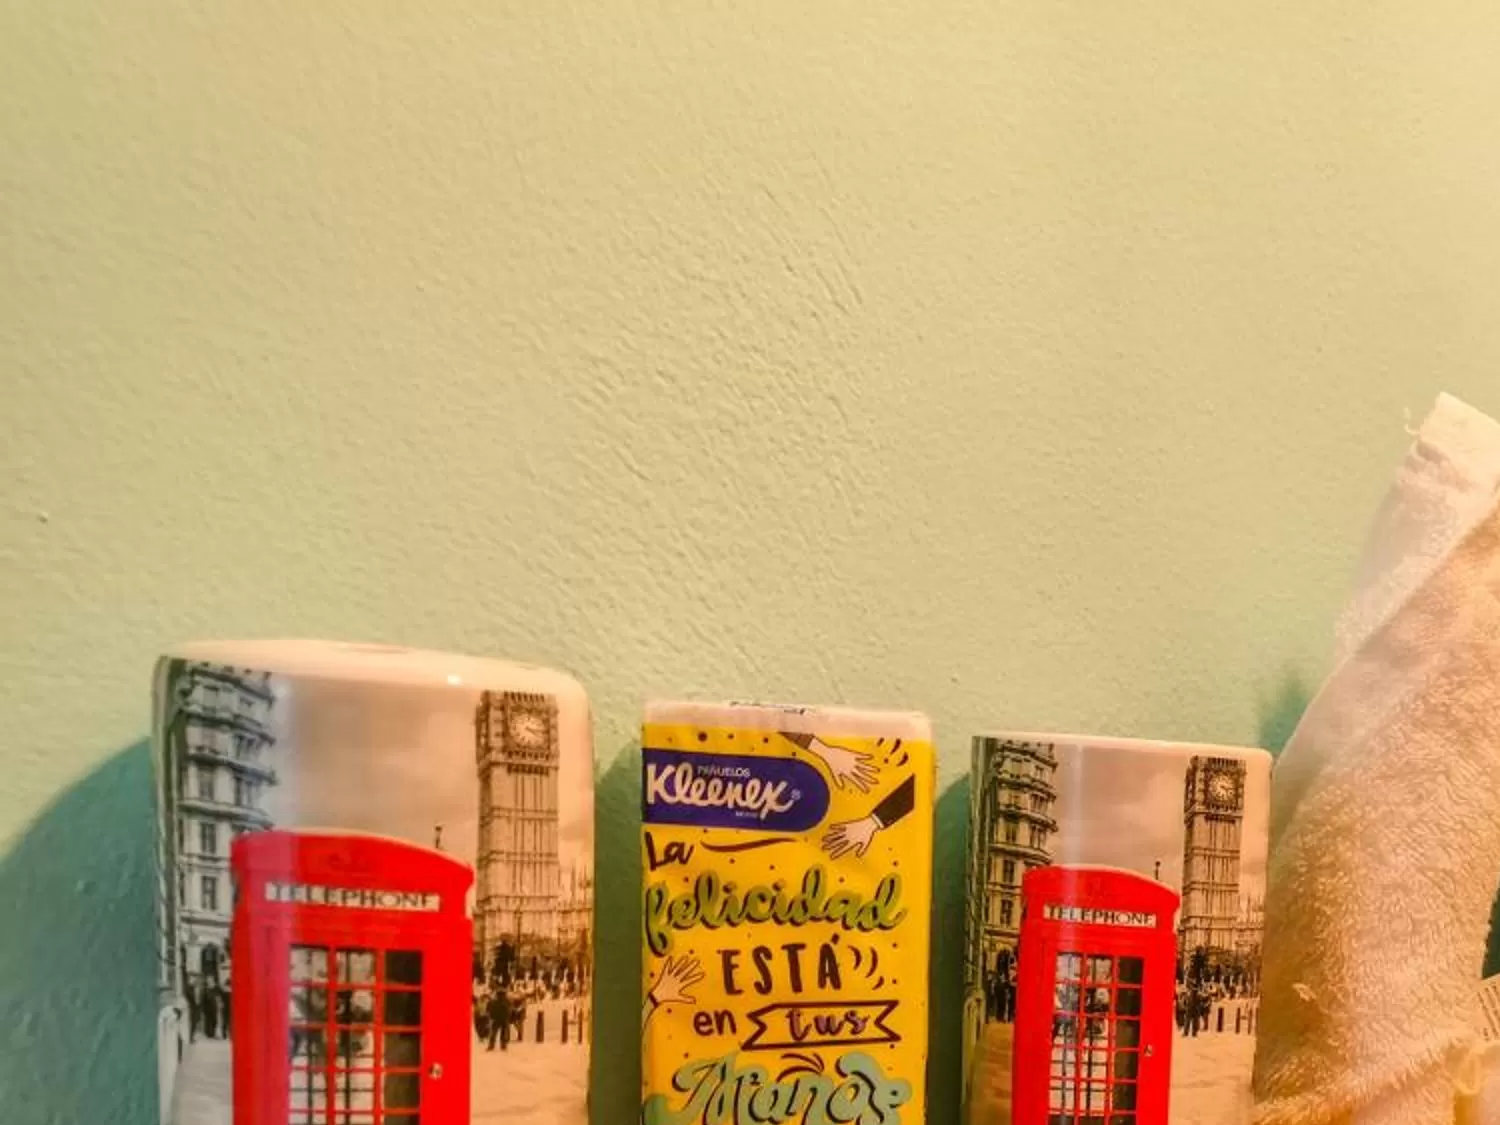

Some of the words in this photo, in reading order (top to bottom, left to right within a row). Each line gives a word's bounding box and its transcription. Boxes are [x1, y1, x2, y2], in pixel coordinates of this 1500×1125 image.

[646, 761, 795, 821] Kleenex
[645, 831, 694, 872] La
[271, 883, 437, 911] TELEPHONE
[644, 864, 907, 958] felicidad
[1047, 905, 1154, 927] TELEPHONE
[717, 934, 842, 995] ESTÁ
[693, 1009, 737, 1036] en
[786, 1008, 873, 1042] tus
